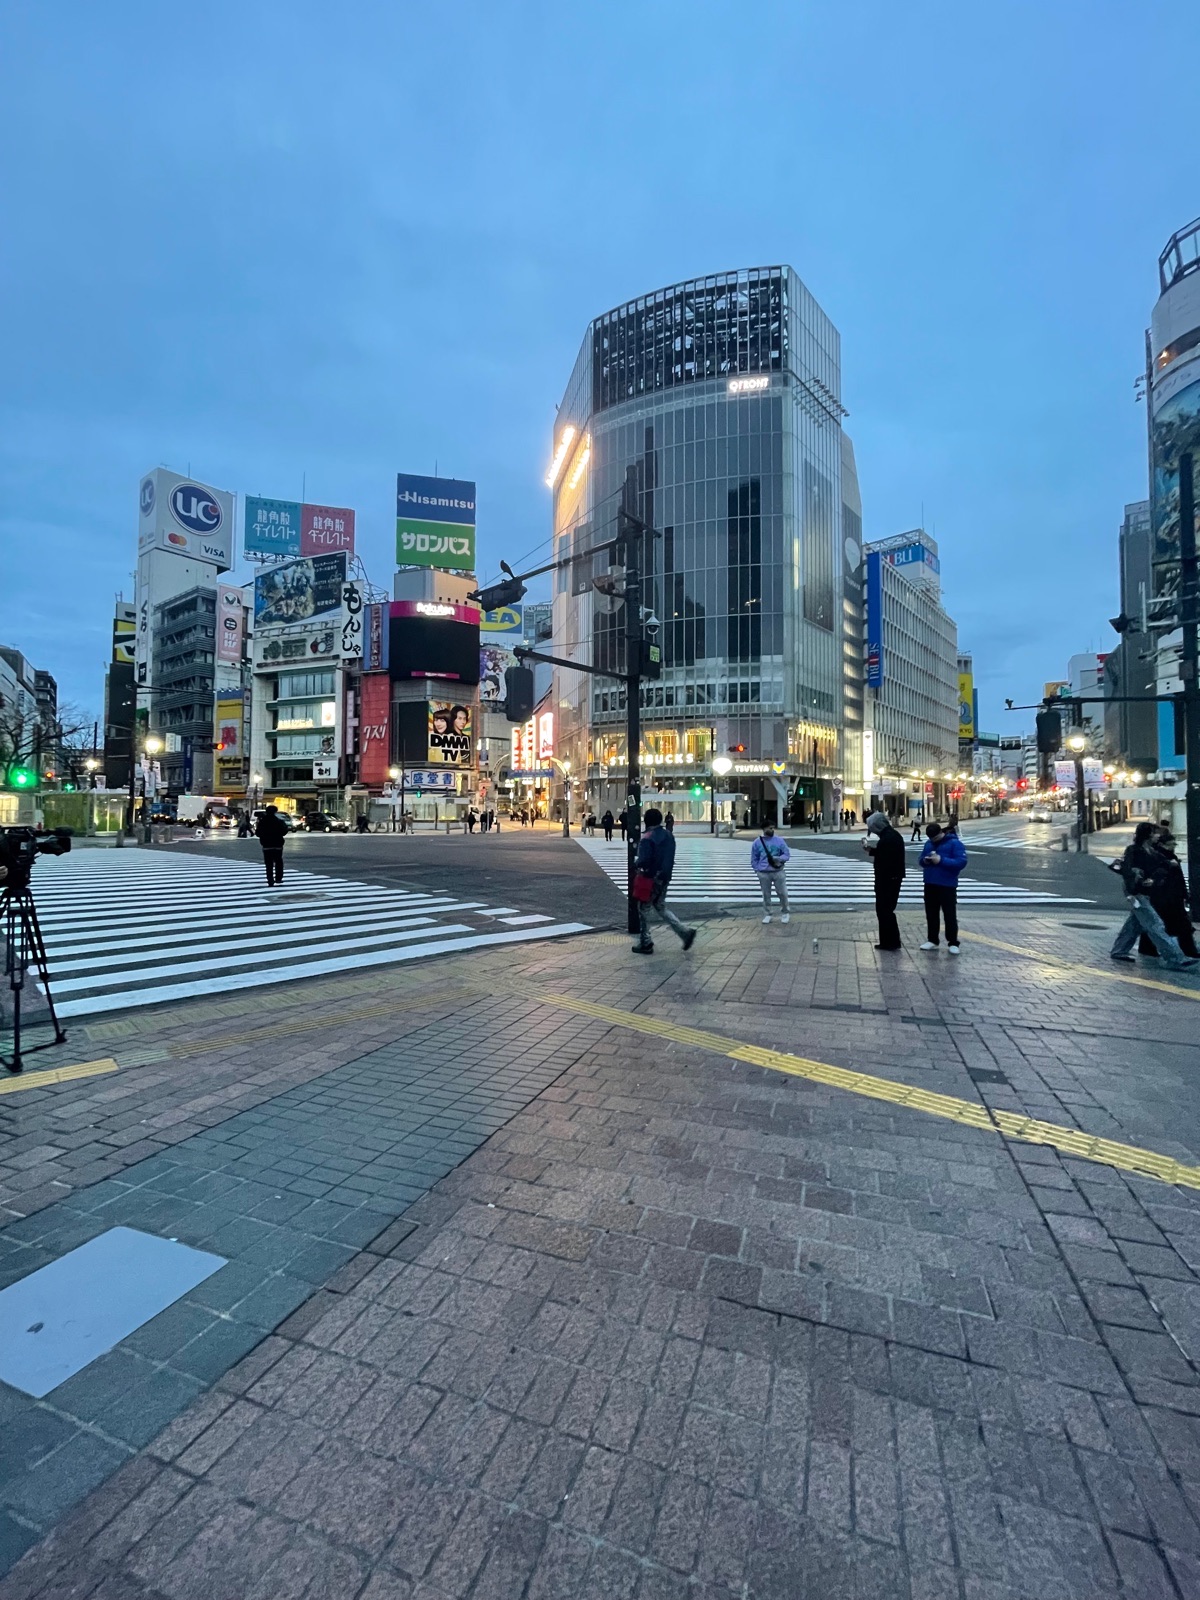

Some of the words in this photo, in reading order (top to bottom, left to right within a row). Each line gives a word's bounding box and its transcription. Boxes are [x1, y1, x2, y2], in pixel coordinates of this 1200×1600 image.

[176, 491, 218, 525] UC
[398, 490, 475, 510] Hisamitsu
[257, 509, 290, 525] 龍角散
[313, 515, 345, 532] 龍角散
[203, 544, 226, 559] VISA
[401, 531, 471, 557] サロンパス
[416, 602, 456, 617] Rakuten
[342, 582, 362, 656] もんじゃ
[869, 643, 880, 680] SEIBU
[362, 716, 388, 753] クスリ
[430, 733, 470, 750] DMM
[441, 749, 459, 762] TV
[735, 764, 770, 773] TSUTAYA
